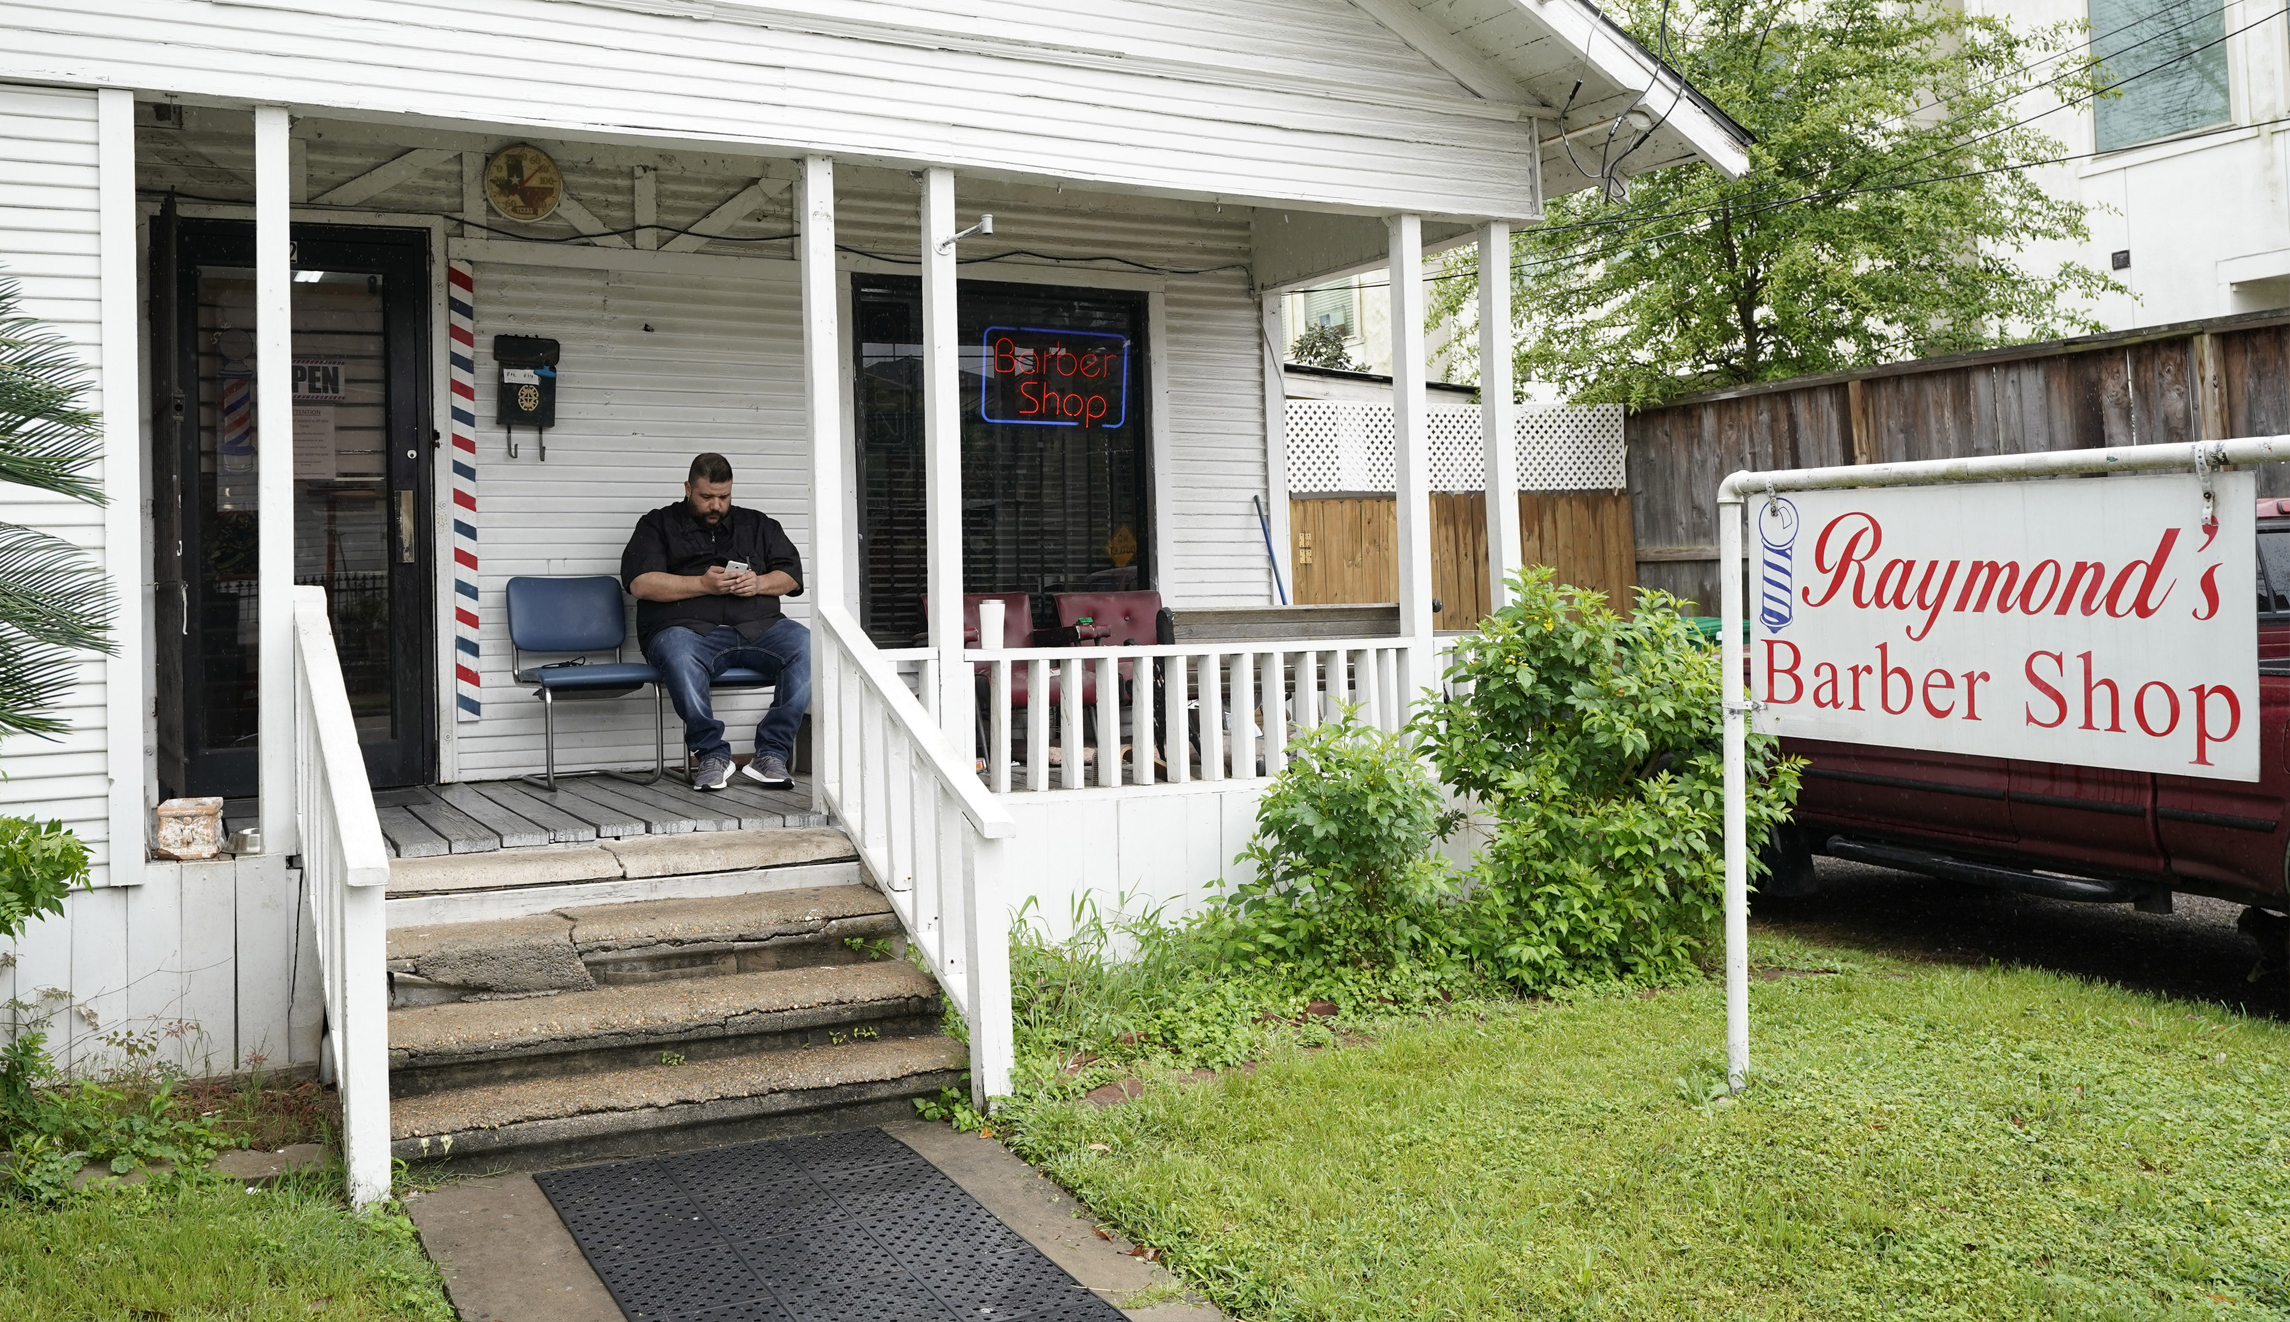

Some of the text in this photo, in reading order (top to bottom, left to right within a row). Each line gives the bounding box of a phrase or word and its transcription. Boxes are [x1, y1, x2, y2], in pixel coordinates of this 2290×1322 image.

[539, 177, 554, 185] 100
[995, 337, 1117, 377] Barber
[292, 365, 339, 394] PEN
[1019, 381, 1107, 428] Shop
[1802, 511, 2223, 642] Raymond's
[1761, 638, 2241, 766] Barber Shop
